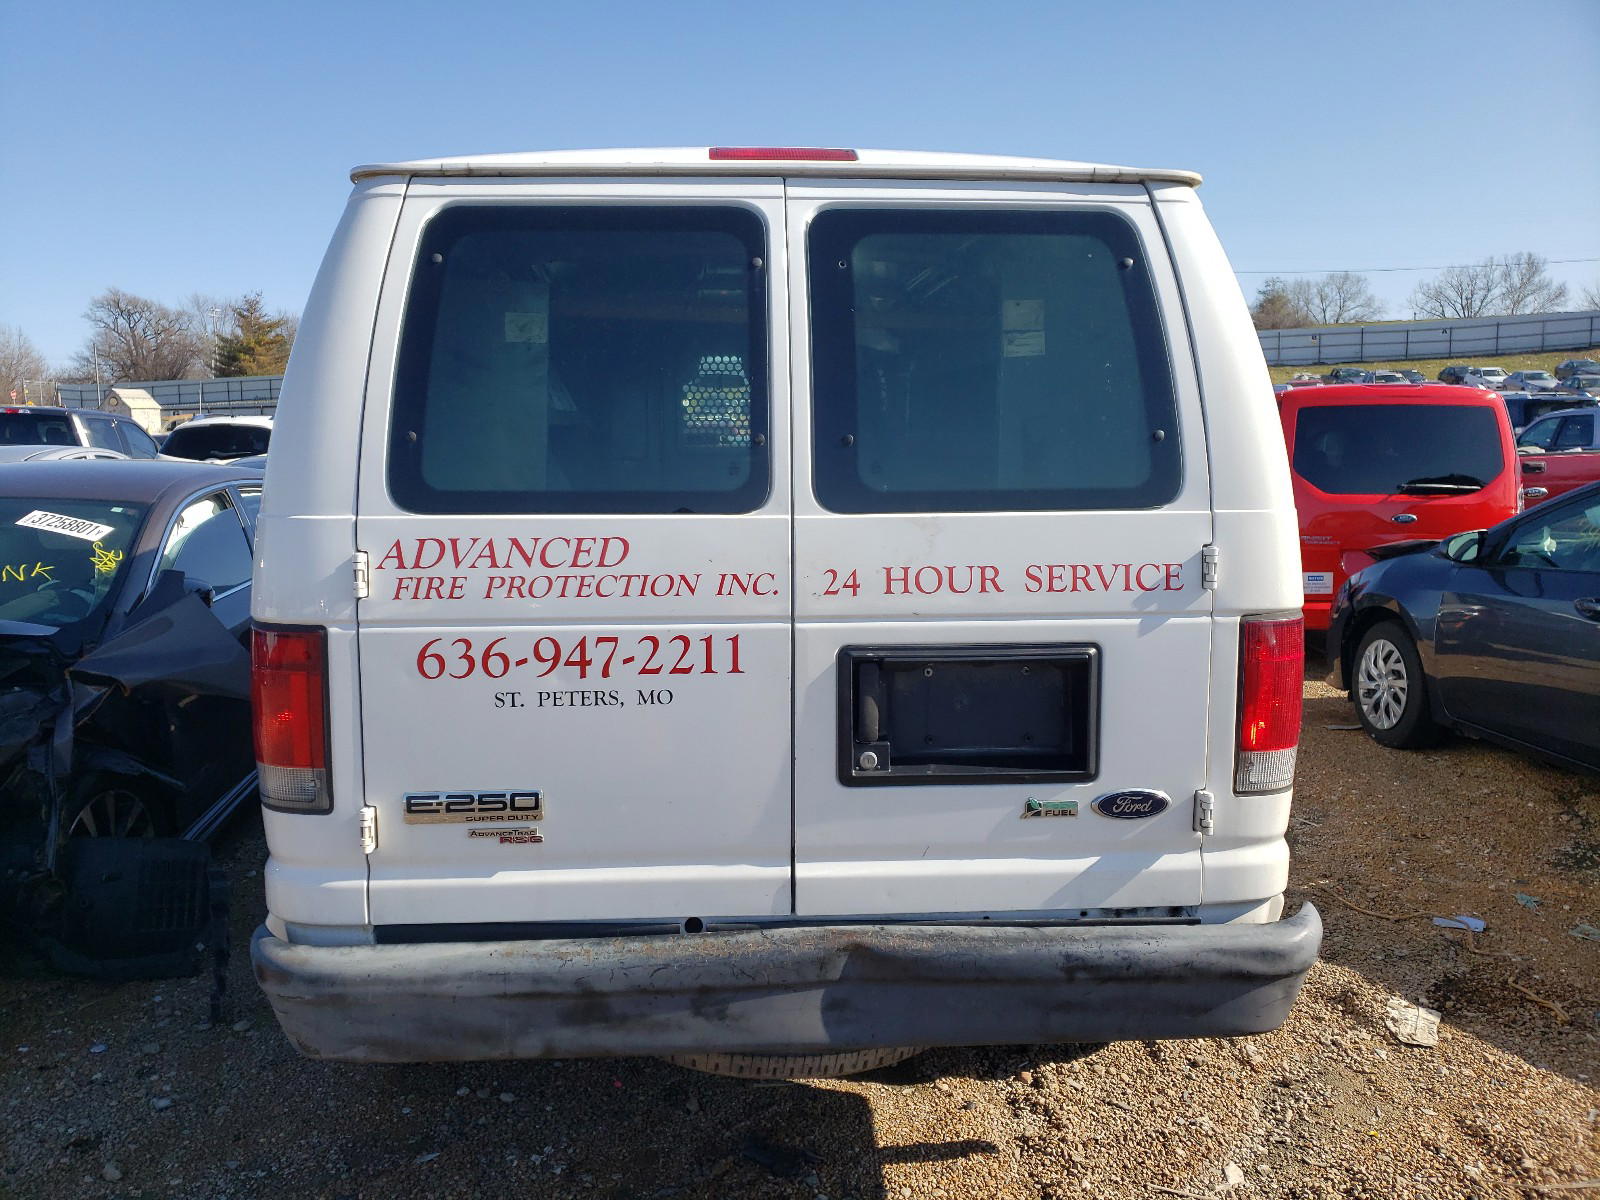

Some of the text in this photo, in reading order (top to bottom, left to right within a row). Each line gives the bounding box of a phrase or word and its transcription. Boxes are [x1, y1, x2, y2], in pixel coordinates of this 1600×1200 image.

[31, 513, 100, 535] 37258801
[375, 536, 630, 570] ADVANCED
[392, 573, 780, 600] FIRE PROTECTION INC.
[822, 563, 1185, 597] 24 HOUR SERVICE
[416, 634, 745, 680] 636-947-2211
[494, 689, 674, 709] ST. PETERS, MO
[405, 792, 540, 814] E-250
[1044, 809, 1077, 817] FUEL
[1112, 796, 1152, 813] Ford
